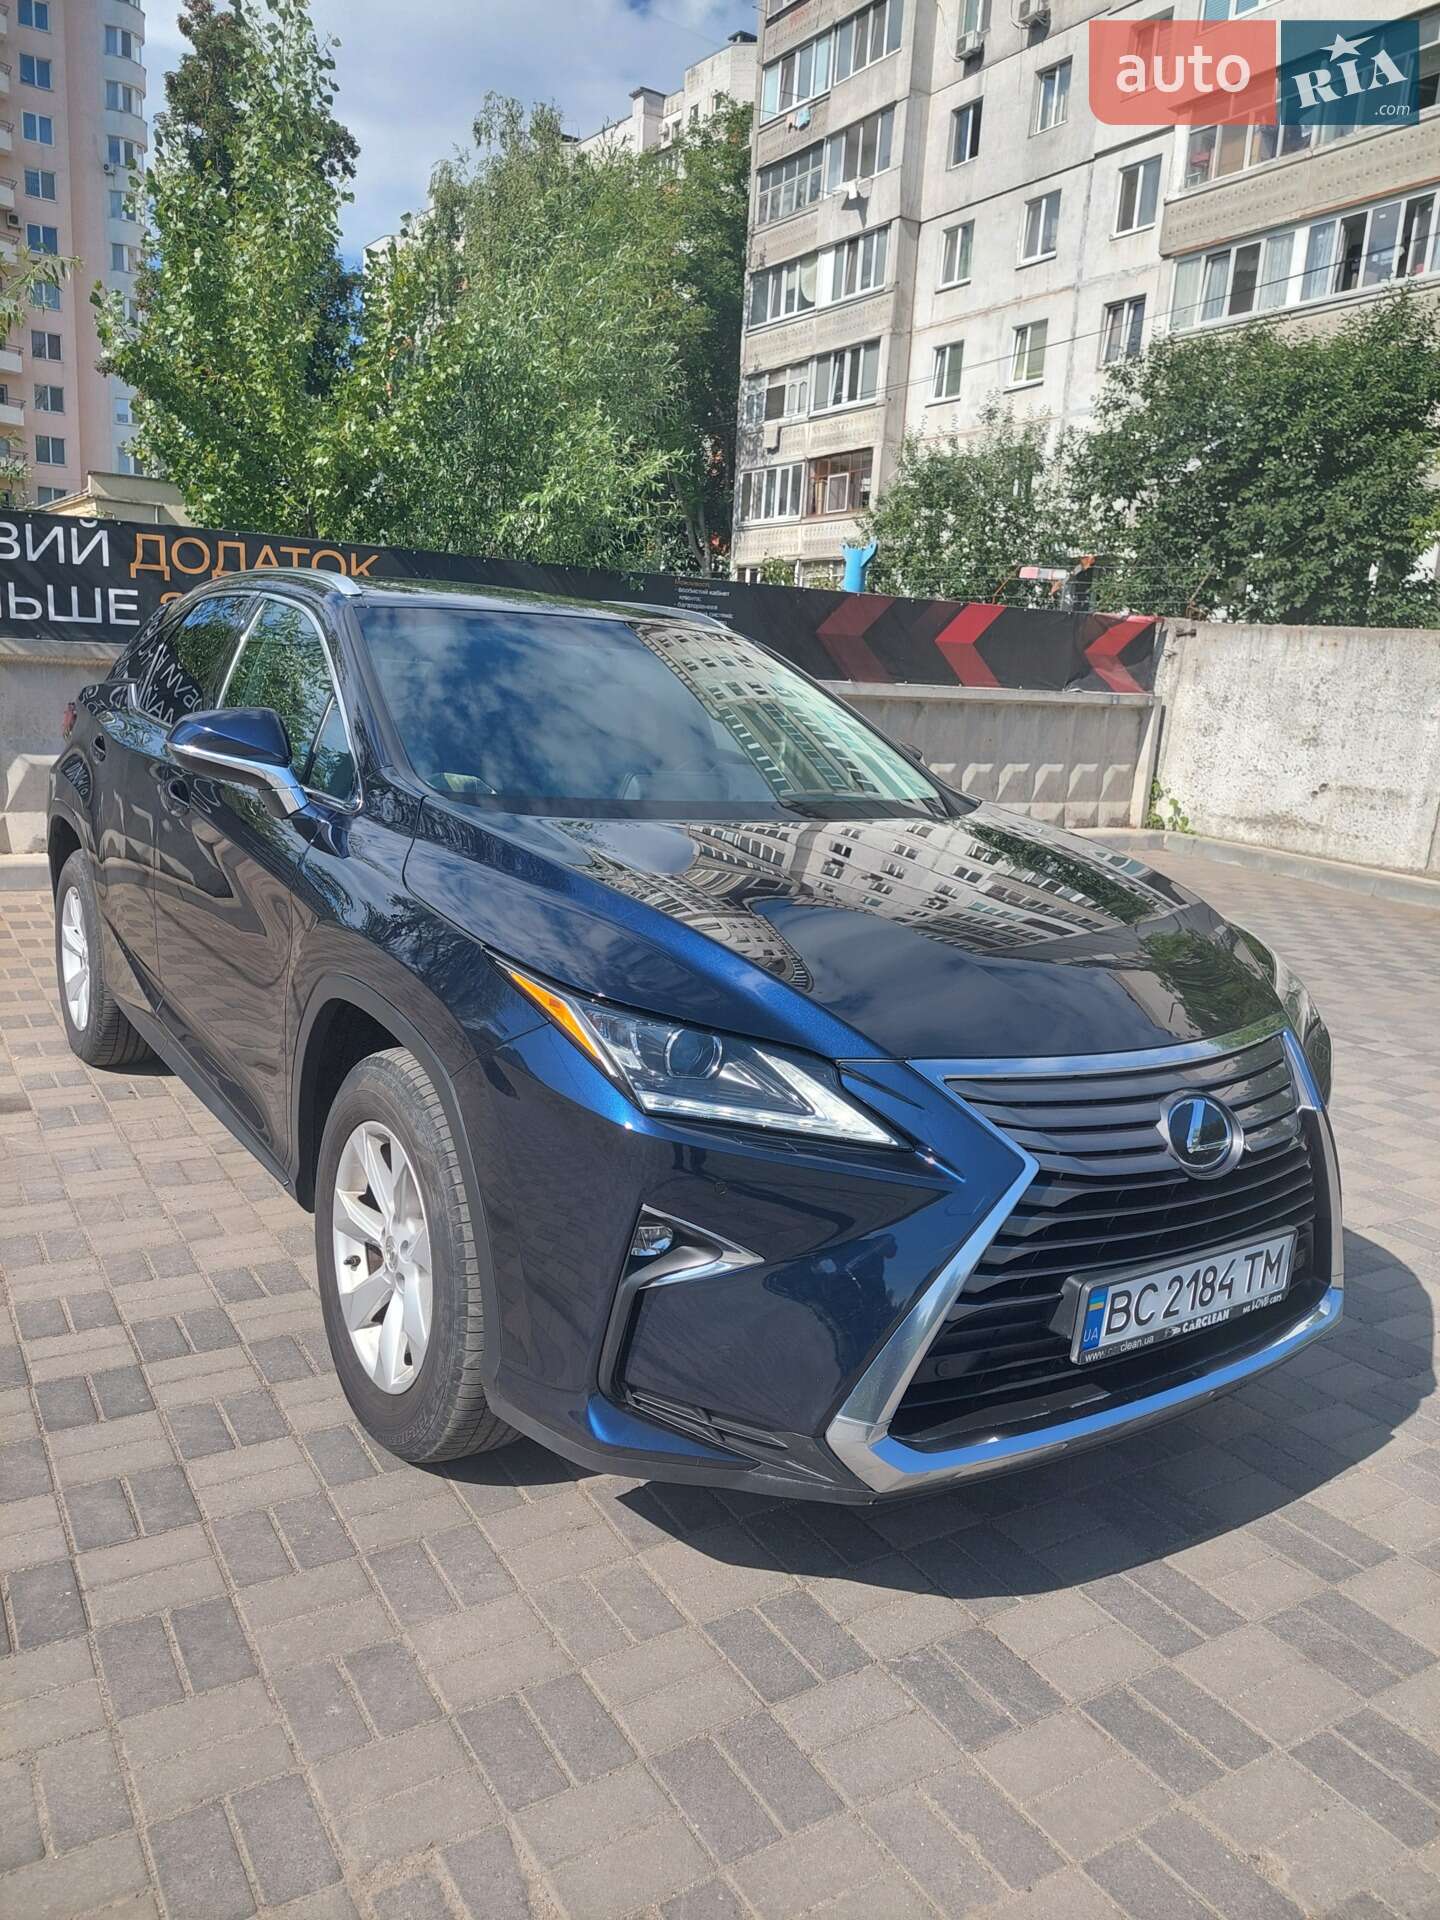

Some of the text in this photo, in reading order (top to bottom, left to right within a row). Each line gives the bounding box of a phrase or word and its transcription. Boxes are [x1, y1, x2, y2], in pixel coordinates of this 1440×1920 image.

[0, 519, 380, 581] ВИЙ ДОДАТОК
[0, 582, 141, 626] ЬШЕ
[1105, 1245, 1285, 1336] BC 2184 TM
[1083, 1327, 1099, 1343] UA
[1182, 1308, 1230, 1334] CARCLEAN
